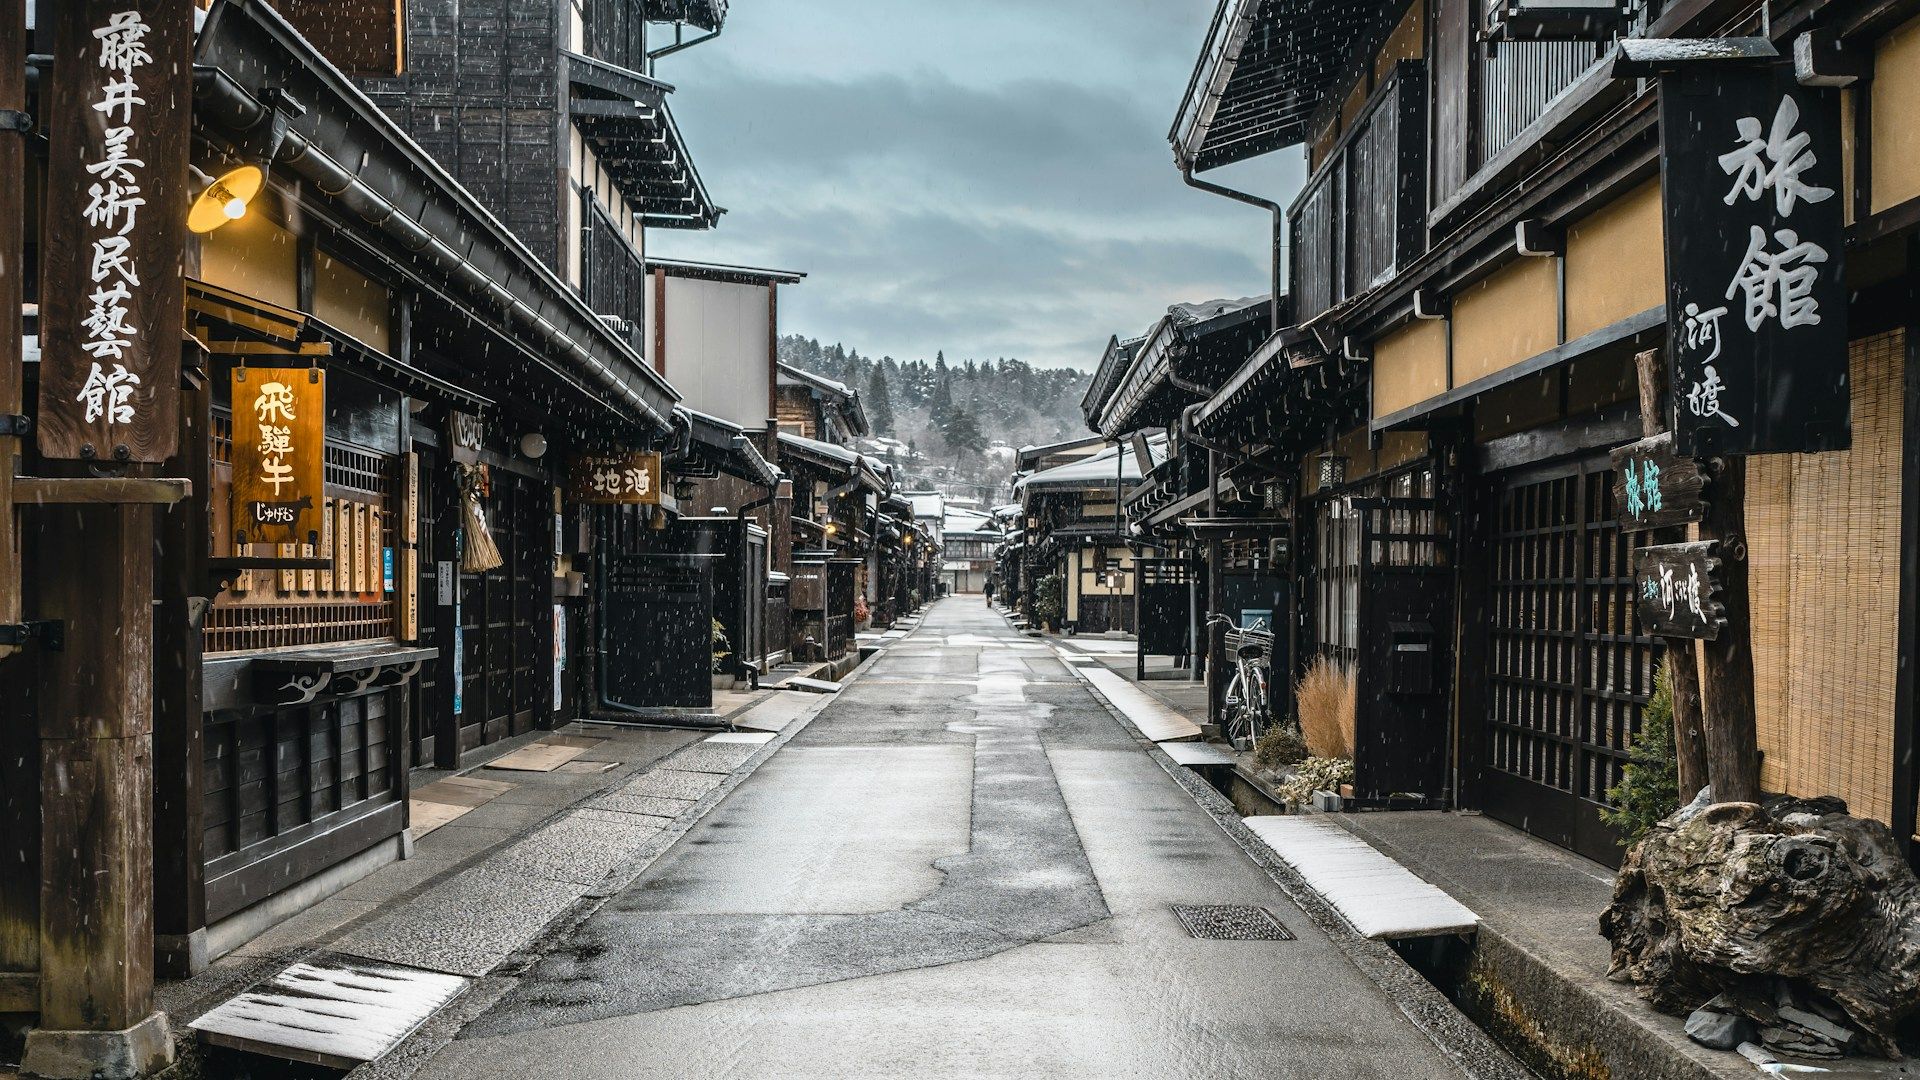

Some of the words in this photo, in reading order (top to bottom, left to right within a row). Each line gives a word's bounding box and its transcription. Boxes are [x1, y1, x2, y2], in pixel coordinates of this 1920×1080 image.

[77, 11, 153, 424] 藤井美術民藝館
[1718, 94, 1835, 332] 旅館
[256, 502, 294, 523] じゅげむ
[593, 467, 651, 496] 地酒
[1625, 458, 1662, 521] 旅館
